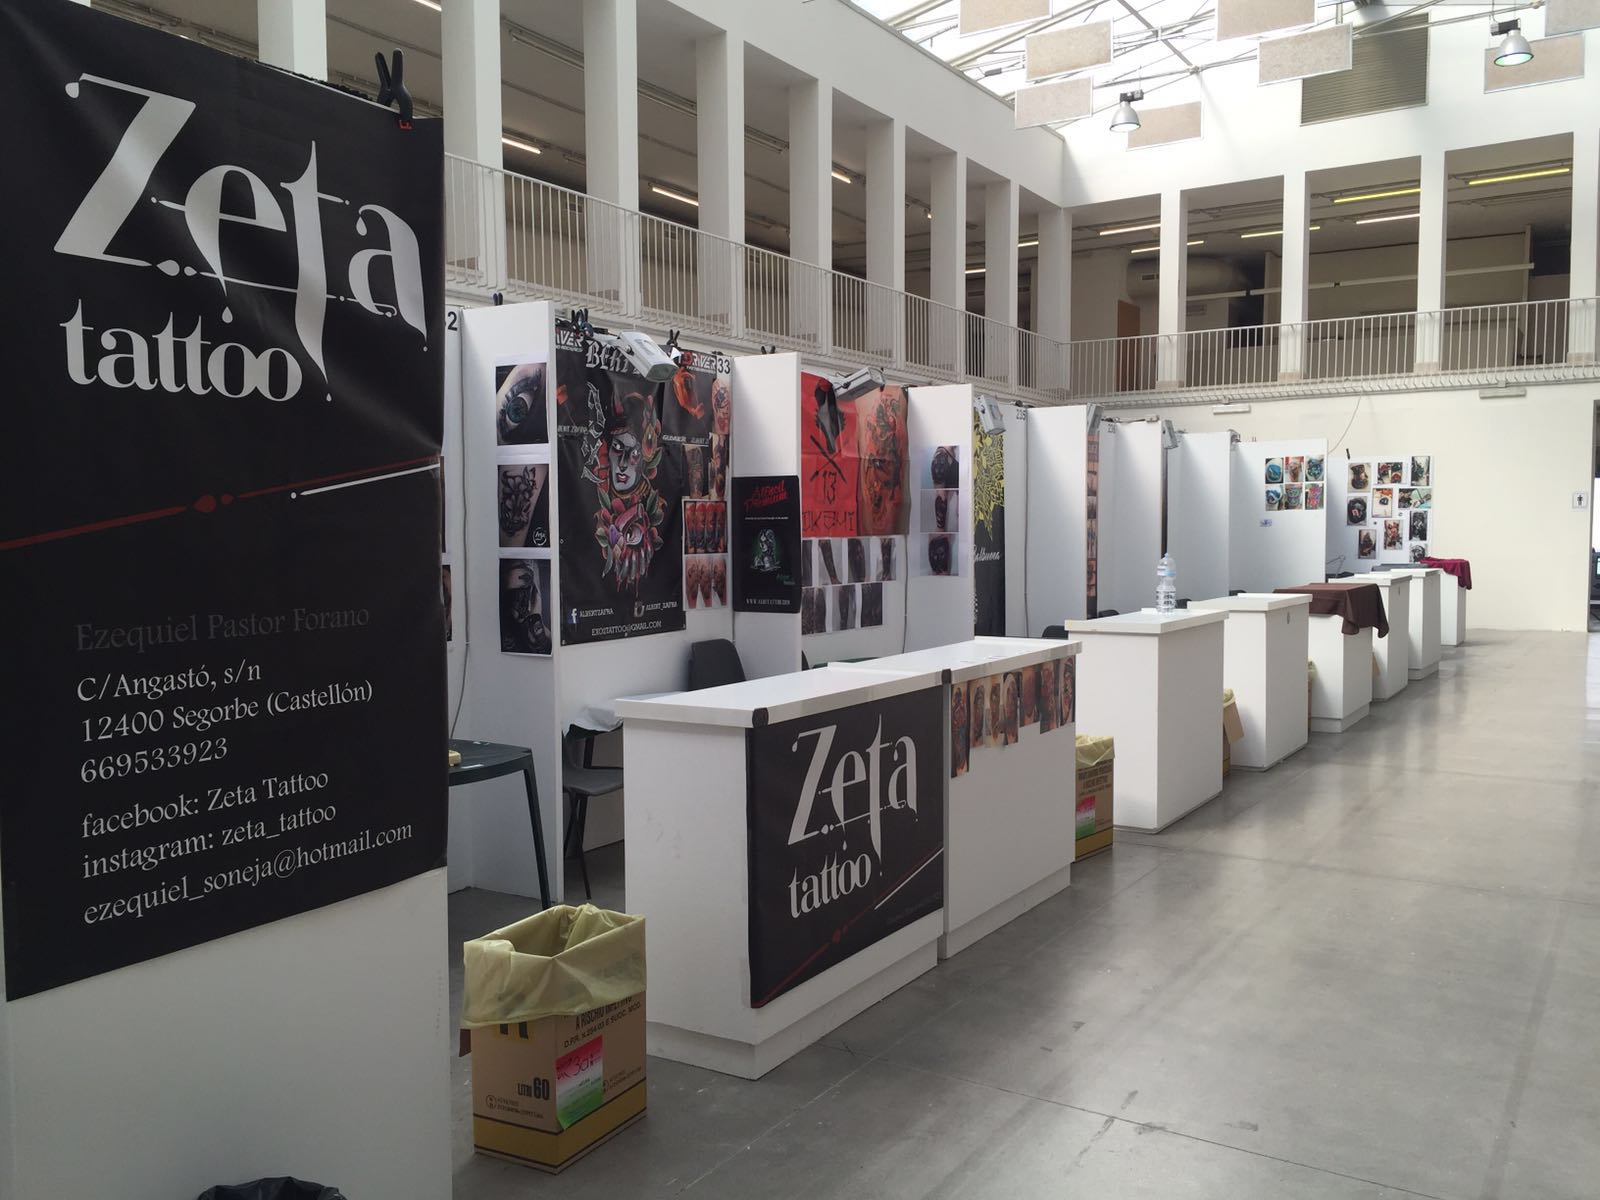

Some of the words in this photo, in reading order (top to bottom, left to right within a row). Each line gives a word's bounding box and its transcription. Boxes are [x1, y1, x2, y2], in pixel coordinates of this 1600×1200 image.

[54, 73, 428, 386] Zeta
[60, 299, 302, 402] tattoo
[75, 614, 199, 654] Ezequiel
[207, 612, 286, 640] Pastor
[293, 607, 370, 632] Forano
[77, 664, 218, 702] C/Angastó,
[223, 659, 262, 685] s/n
[83, 709, 165, 743] 12400
[172, 696, 259, 731] Segorbe
[267, 679, 374, 717] (Castellón)
[80, 737, 229, 784] 669533923
[788, 713, 918, 865] Zeta
[81, 793, 200, 839] facebook:
[207, 787, 256, 812] Zeta
[262, 771, 329, 800] Tattoo
[82, 831, 215, 880] instagram:
[221, 804, 337, 848] zeta_tattoo
[83, 823, 414, 925] ezequiel_soneja@hotmail.com
[788, 851, 872, 919] tattoo
[533, 1077, 550, 1101] 60
